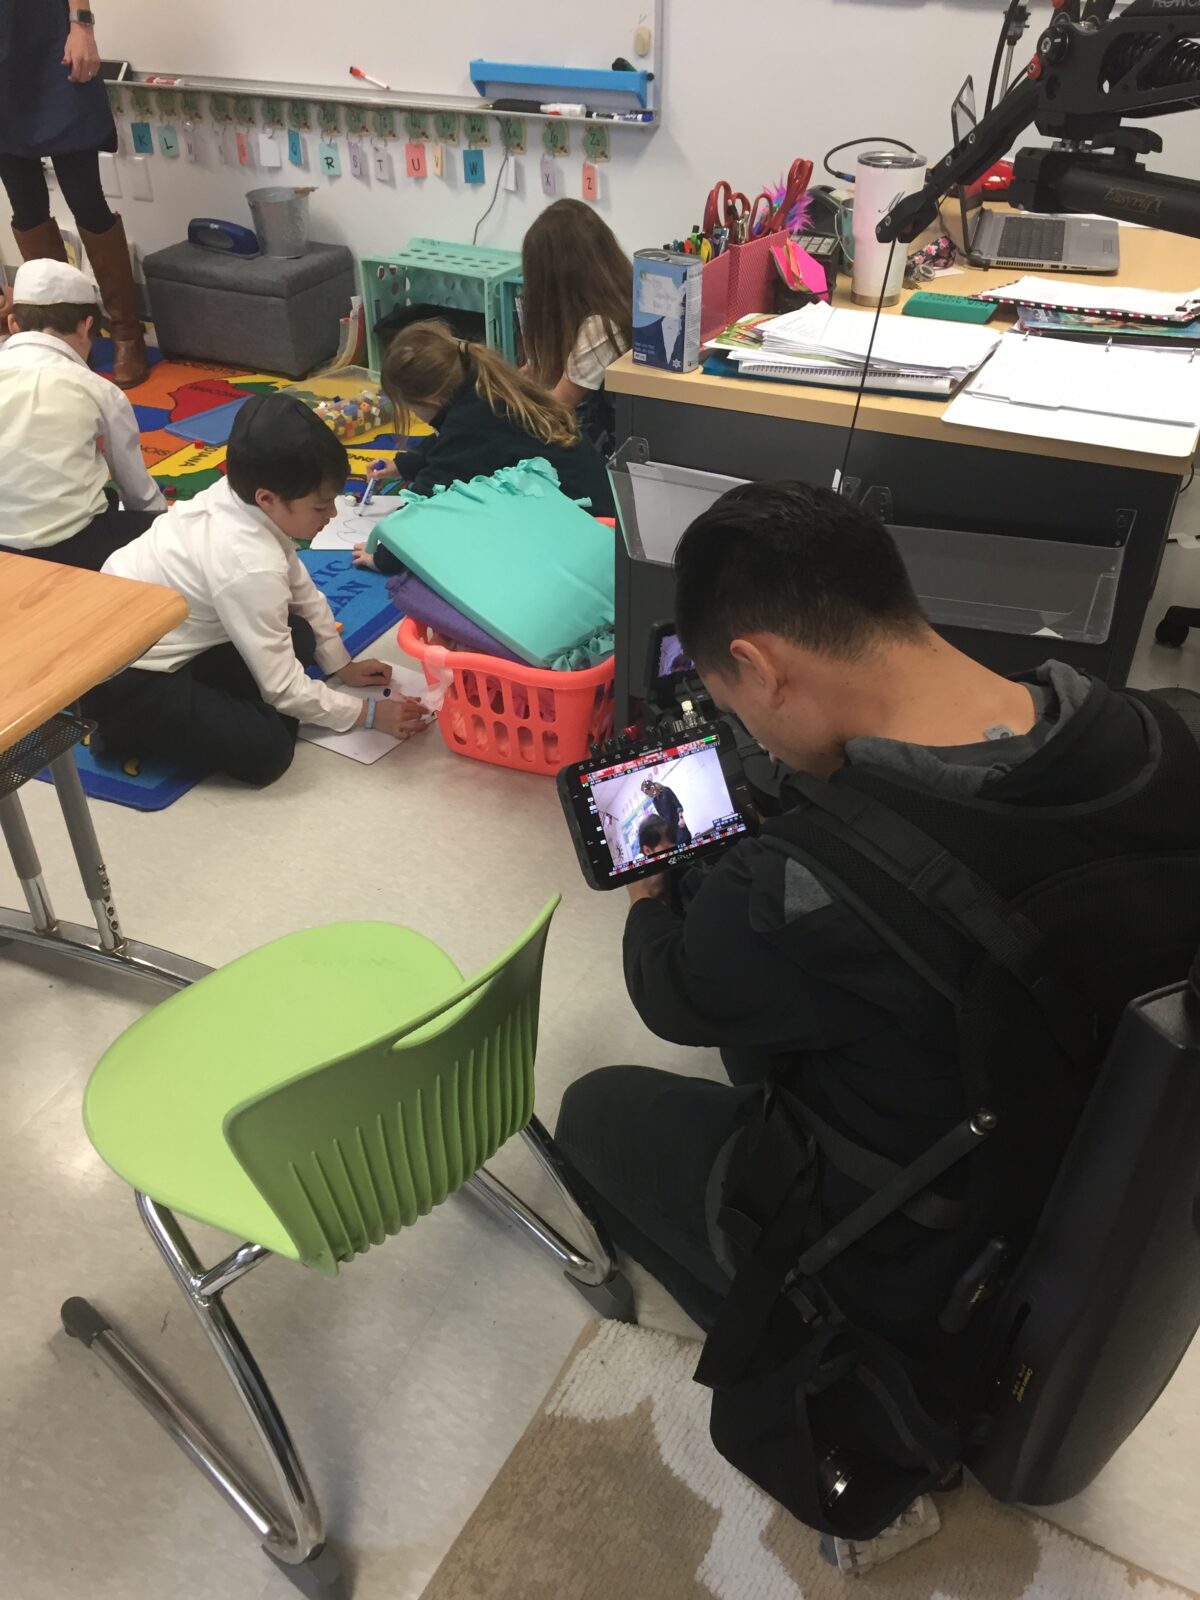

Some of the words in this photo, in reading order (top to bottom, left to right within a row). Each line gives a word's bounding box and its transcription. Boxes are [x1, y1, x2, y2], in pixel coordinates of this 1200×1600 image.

[138, 135, 148, 145] K
[163, 137, 174, 150] L
[323, 156, 336, 170] R
[376, 159, 384, 172] T
[411, 158, 421, 172] U
[468, 162, 478, 176] W
[586, 176, 593, 191] Z
